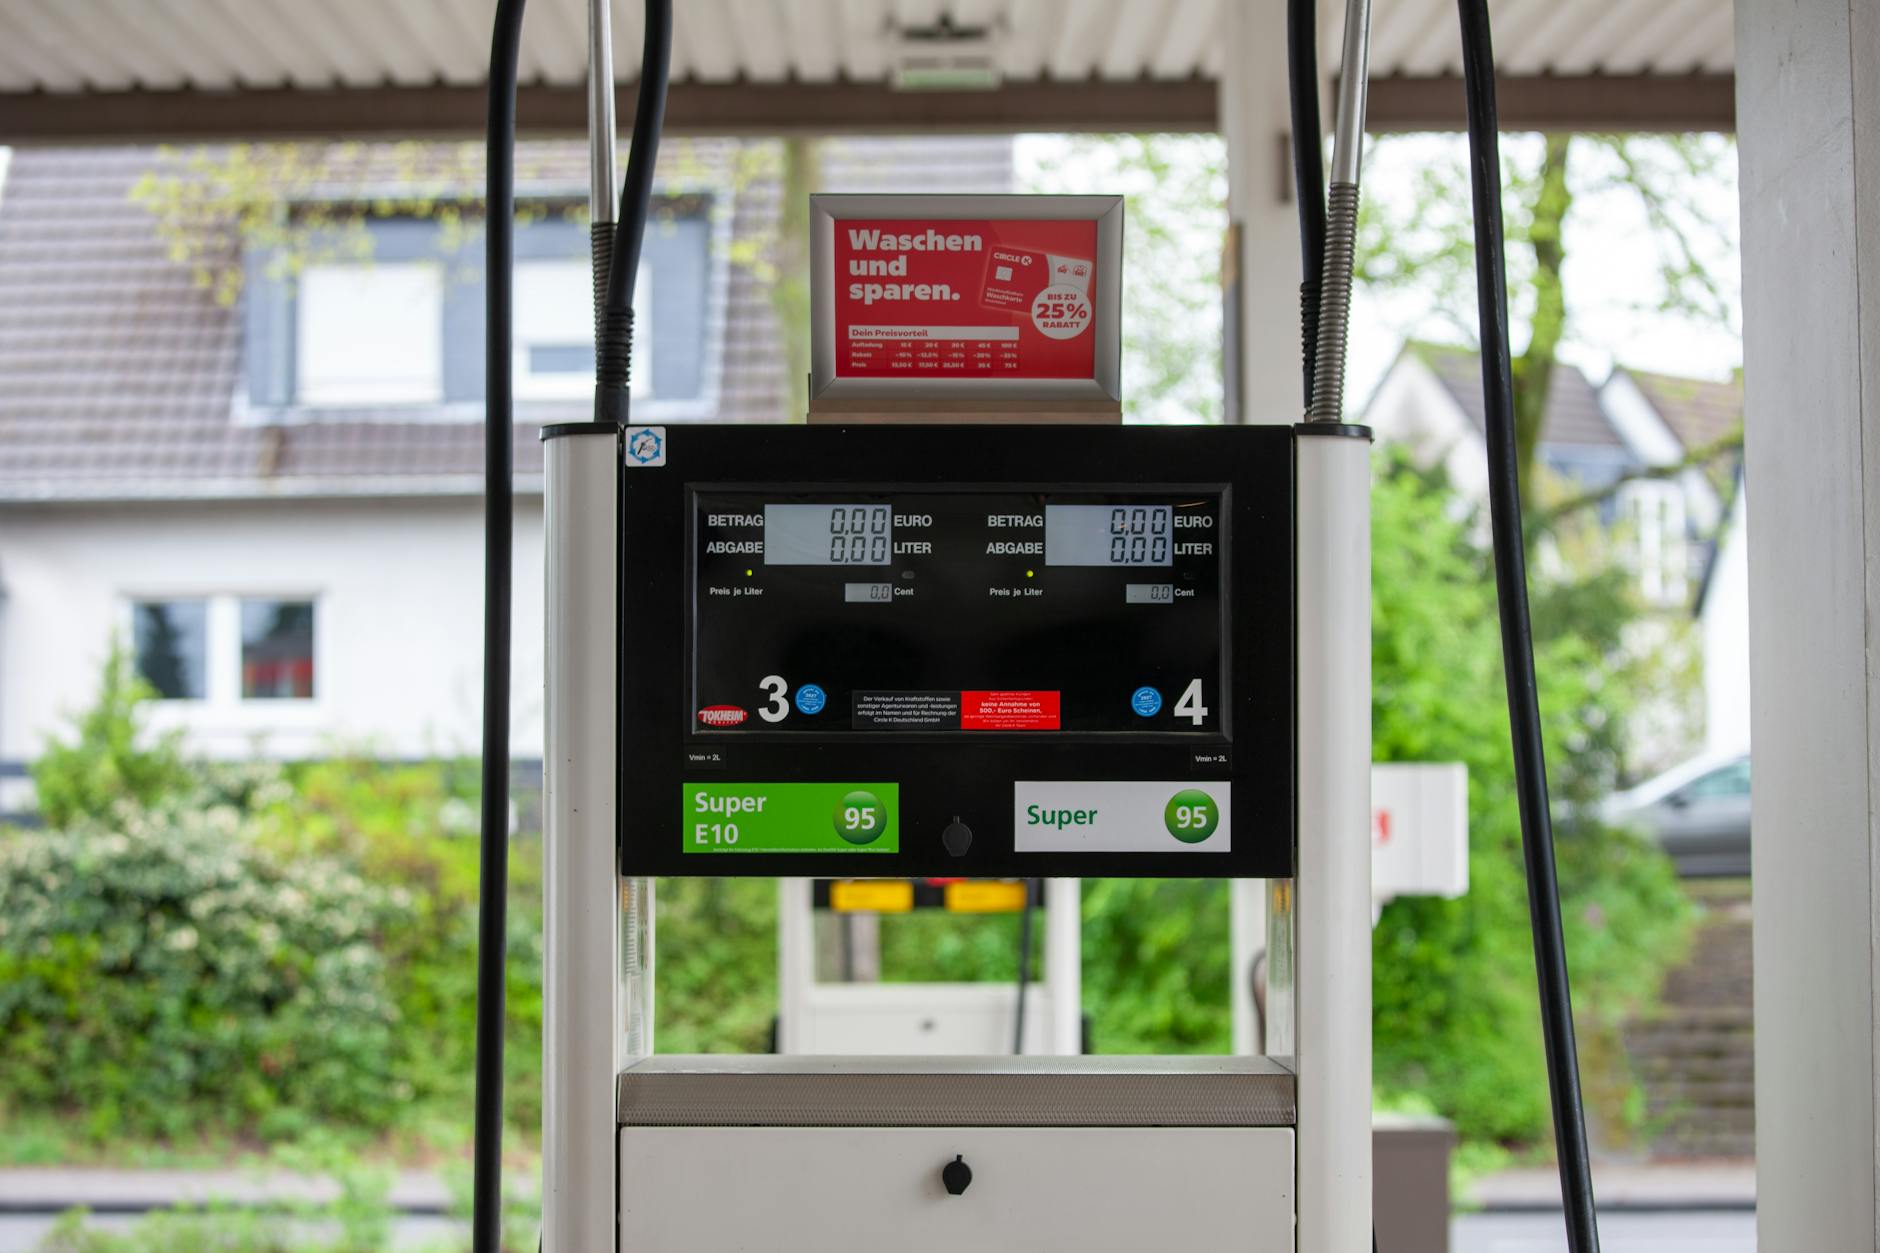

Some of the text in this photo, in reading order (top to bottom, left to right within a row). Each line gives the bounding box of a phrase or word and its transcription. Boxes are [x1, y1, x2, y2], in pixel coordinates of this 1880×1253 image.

[848, 229, 983, 251] Waschen
[993, 252, 1020, 263] CIRCLE
[849, 255, 907, 276] und
[849, 283, 960, 305] sparen.
[986, 292, 1023, 303] Waschkarte
[1036, 303, 1087, 319] 25%
[1042, 321, 1081, 329] RABATT
[852, 329, 928, 337] Dein Preisvorteil
[708, 514, 764, 527] BETRAG
[830, 508, 887, 535] 0,00
[894, 514, 933, 527] EURO
[987, 515, 1044, 527] BETRAG
[1110, 508, 1167, 536] 0,00
[1174, 515, 1213, 528] EURO
[706, 541, 764, 554] ABGABE
[830, 536, 887, 563] 0,00
[894, 541, 932, 554] LITER
[986, 542, 1044, 555] ABGABE
[1110, 536, 1167, 563] 0,00
[1174, 542, 1212, 555] LITER
[709, 587, 763, 597] Preis je Liter
[870, 586, 890, 600] 0,0
[894, 587, 914, 596] Cent
[989, 588, 1043, 598] Preis je Liter
[1151, 586, 1170, 601] 0,0
[1174, 588, 1194, 597] Cent
[758, 675, 790, 722] 3
[1174, 679, 1208, 725] 4
[700, 710, 744, 721] TOKHEIM
[695, 792, 767, 817] Super
[844, 807, 876, 830] 95
[1027, 805, 1098, 830] Super
[1176, 806, 1207, 829] 95
[695, 823, 739, 844] E10
